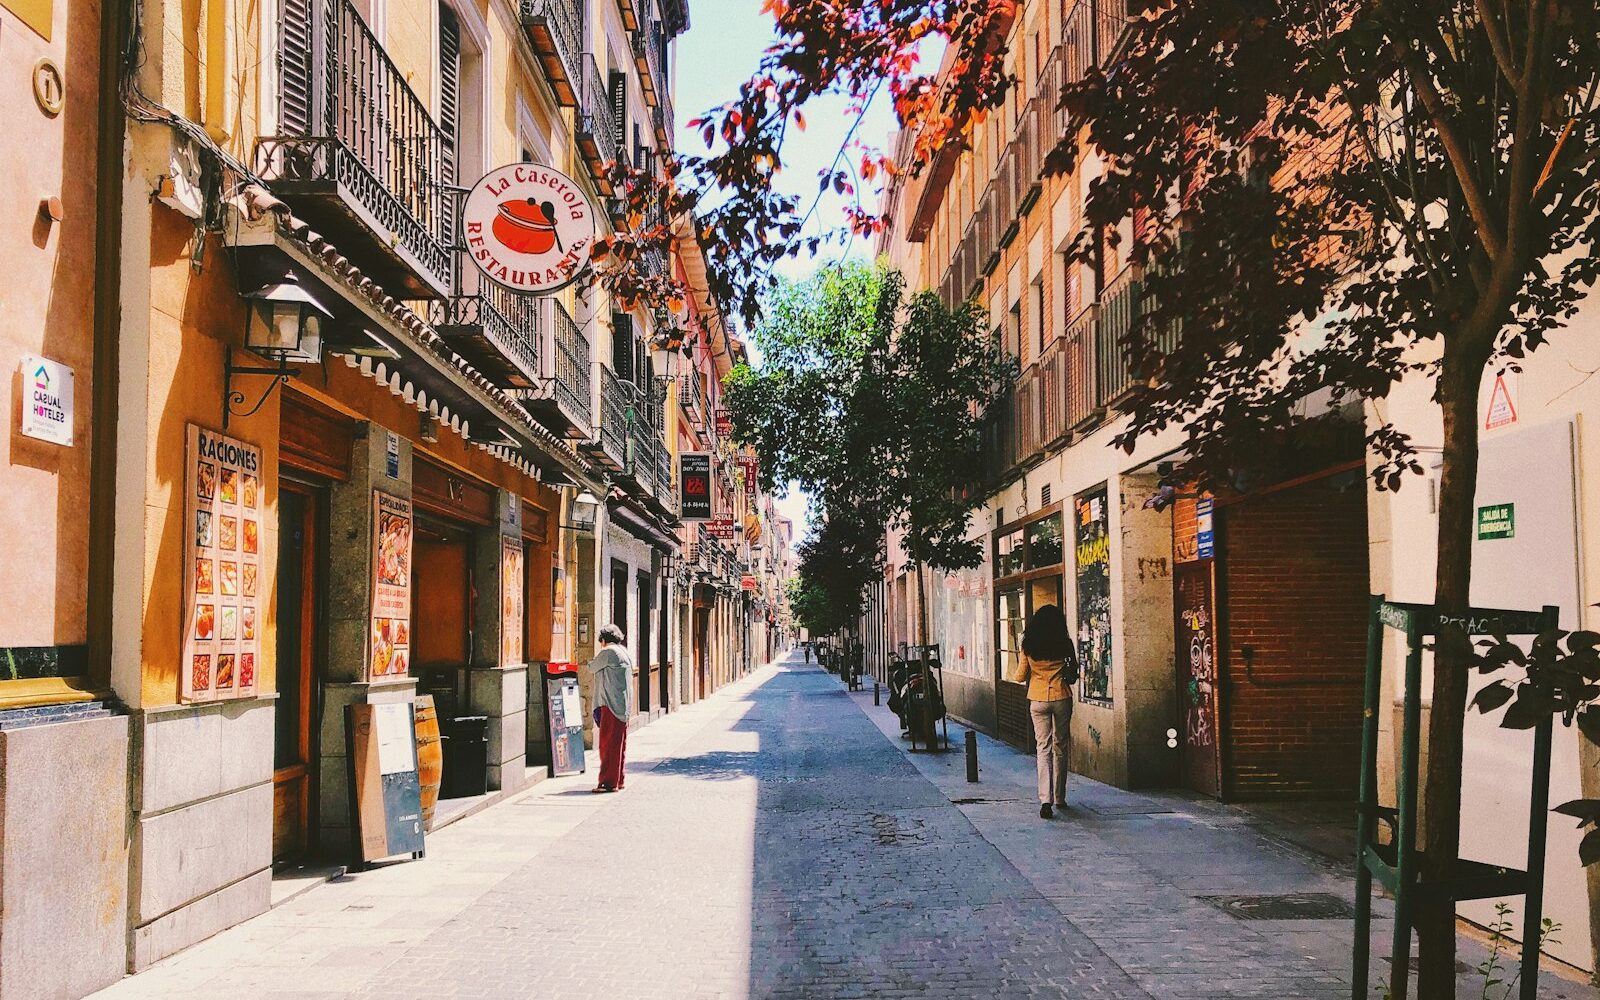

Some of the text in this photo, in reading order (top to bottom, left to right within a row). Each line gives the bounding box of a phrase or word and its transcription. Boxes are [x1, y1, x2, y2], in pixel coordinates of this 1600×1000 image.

[485, 166, 585, 221] La Caserola
[34, 390, 61, 409] CASUAL
[33, 404, 65, 423] HOTELES
[198, 433, 257, 472] RACIONES
[747, 468, 755, 493] LIDO
[1482, 508, 1509, 521] SALIDA DE
[1480, 520, 1512, 534] EMERGENCIA
